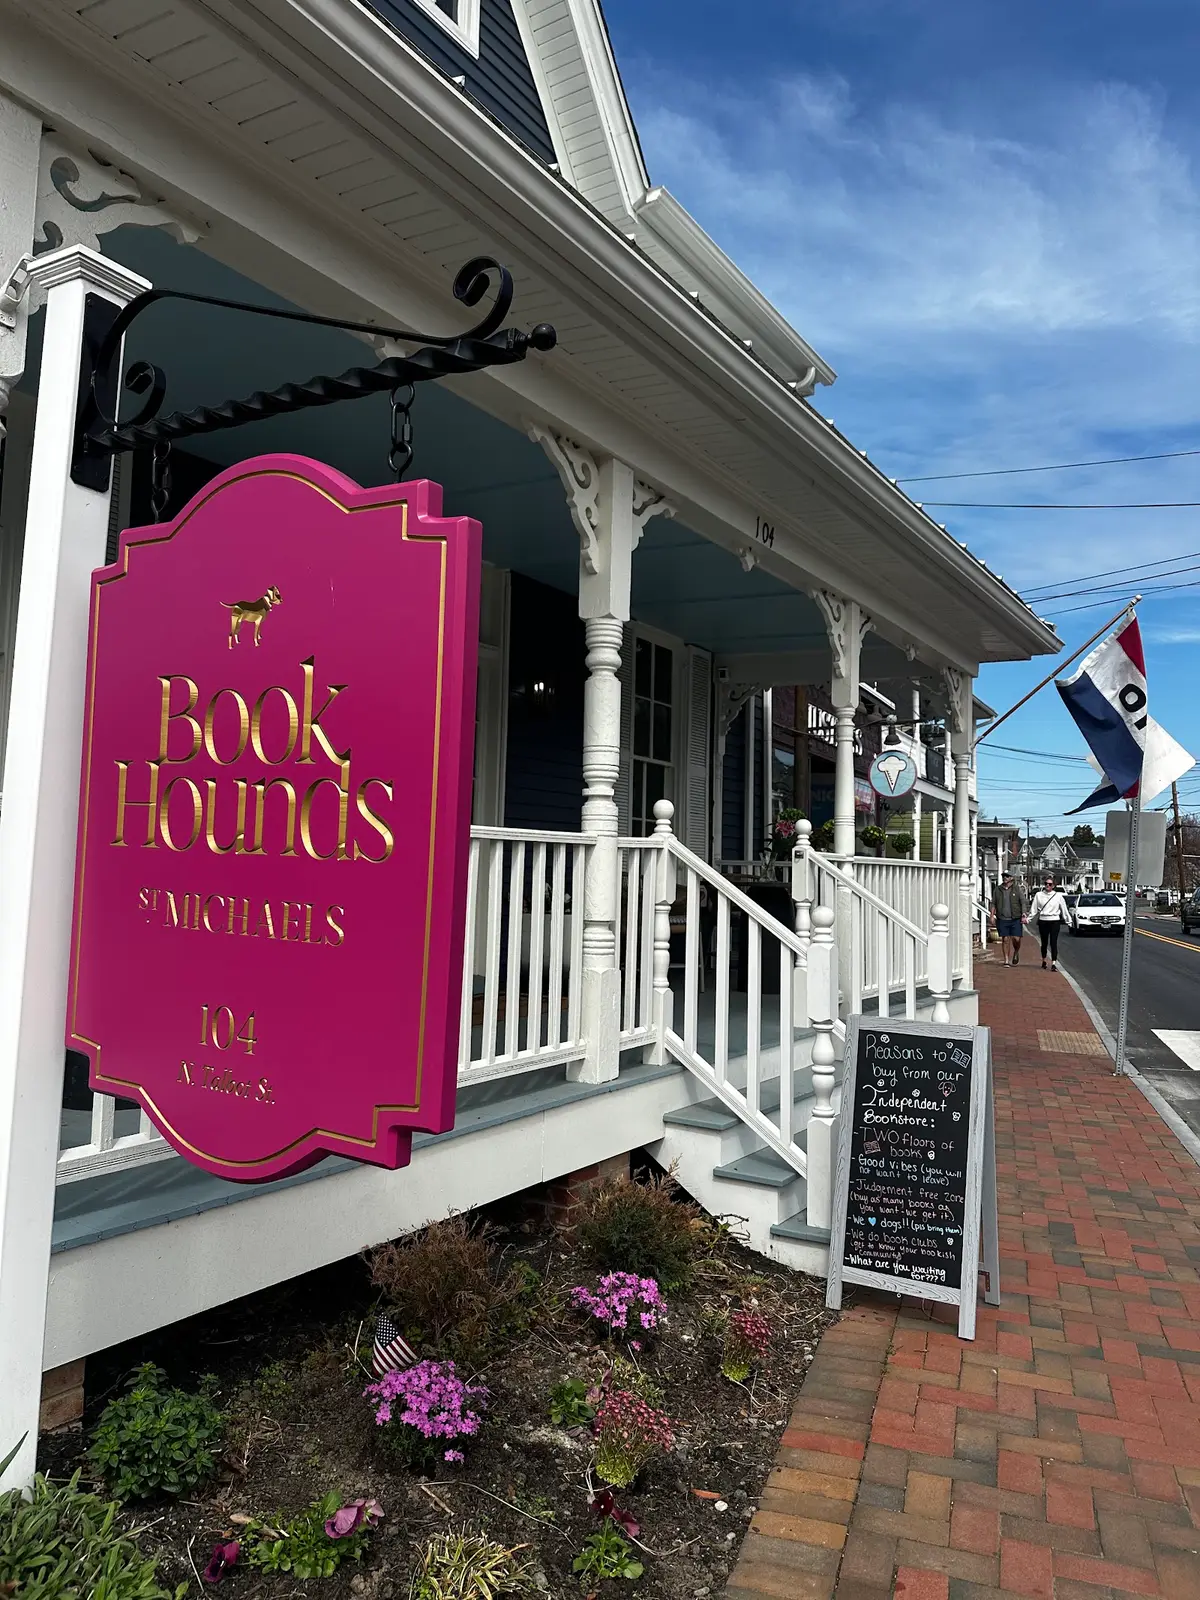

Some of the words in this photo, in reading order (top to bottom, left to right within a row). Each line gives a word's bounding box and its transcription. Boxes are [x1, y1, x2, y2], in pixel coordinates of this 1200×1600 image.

[755, 515, 775, 548] 104
[156, 654, 352, 767] Book
[110, 758, 395, 864] Hounds
[162, 889, 345, 947] MICHAELS
[198, 1003, 257, 1056] 104
[865, 1033, 924, 1061] Reasons
[932, 1050, 947, 1062] to
[176, 1059, 196, 1086] N.
[201, 1065, 252, 1099] Talbot
[255, 1077, 276, 1105] St.
[872, 1063, 899, 1087] buy
[902, 1066, 931, 1080] from
[936, 1070, 964, 1082] our
[861, 1084, 948, 1113] Independent
[859, 1126, 900, 1145] TWO
[902, 1132, 936, 1149] floors
[940, 1140, 955, 1152] of
[858, 1154, 885, 1168] Good
[890, 1145, 923, 1160] books
[855, 1178, 913, 1197] Judgement
[919, 1188, 939, 1201] free
[907, 1173, 918, 1182] to
[859, 1203, 876, 1214] you
[922, 1211, 937, 1222] get
[882, 1197, 904, 1209] many
[908, 1200, 935, 1210] books
[937, 1204, 950, 1212] as
[868, 1231, 880, 1242] do
[883, 1232, 909, 1245] book
[874, 1259, 891, 1270] are
[892, 1262, 912, 1276] you
